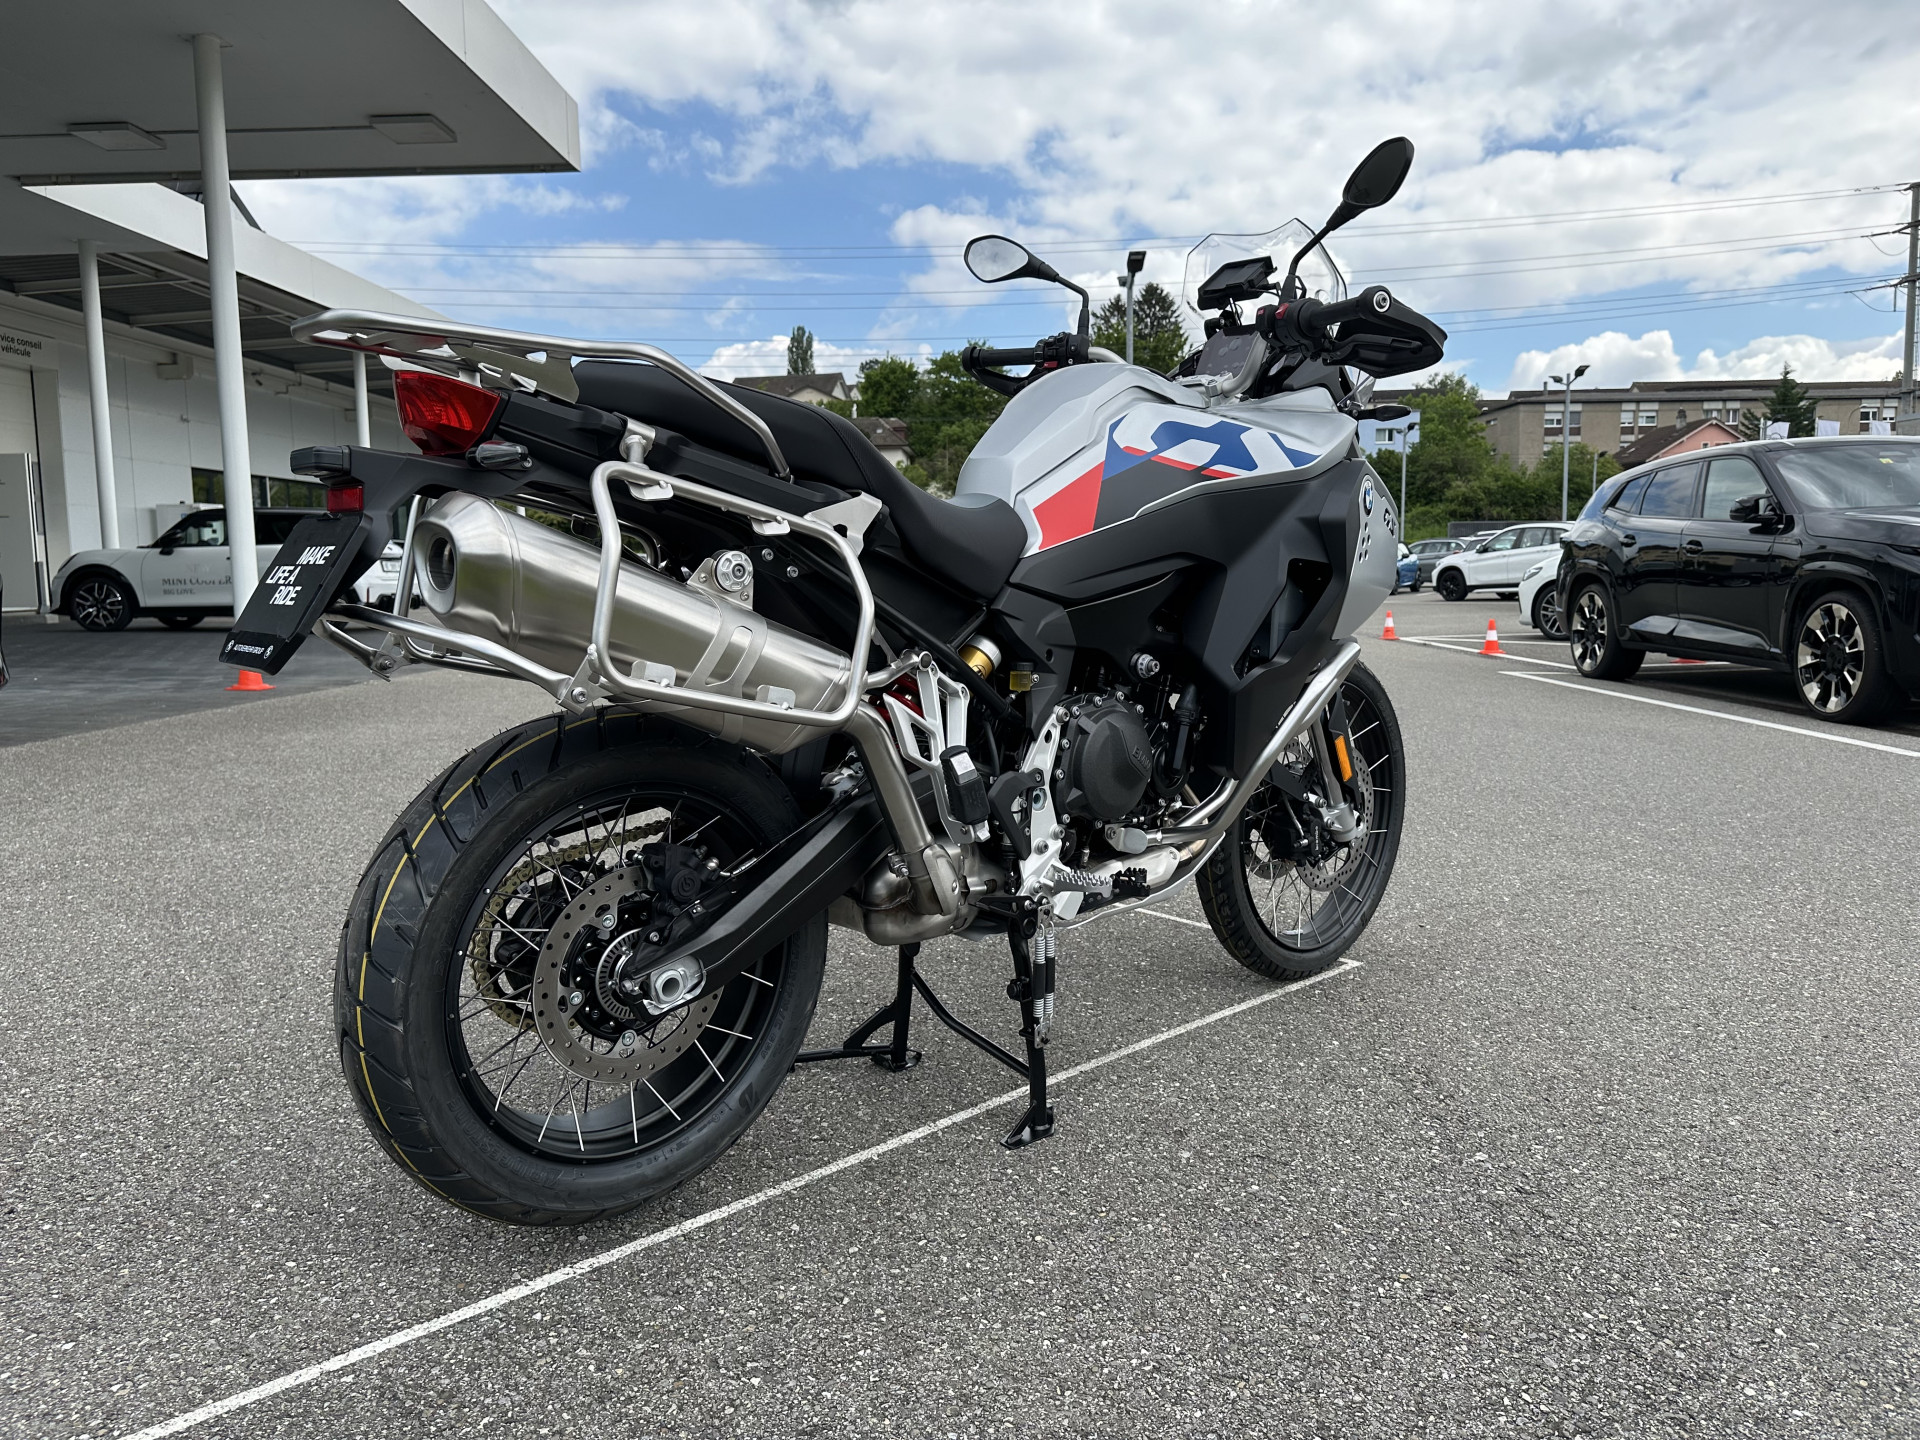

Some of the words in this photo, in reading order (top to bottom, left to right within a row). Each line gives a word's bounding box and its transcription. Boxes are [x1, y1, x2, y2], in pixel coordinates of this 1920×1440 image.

[0, 333, 15, 344] vice
[17, 338, 42, 350] conseil
[1, 344, 31, 357] véhicule
[296, 546, 336, 565] MAKE
[162, 578, 187, 586] MINI
[265, 566, 295, 584] LIFE
[284, 565, 302, 585] A
[269, 585, 303, 606] RIDE
